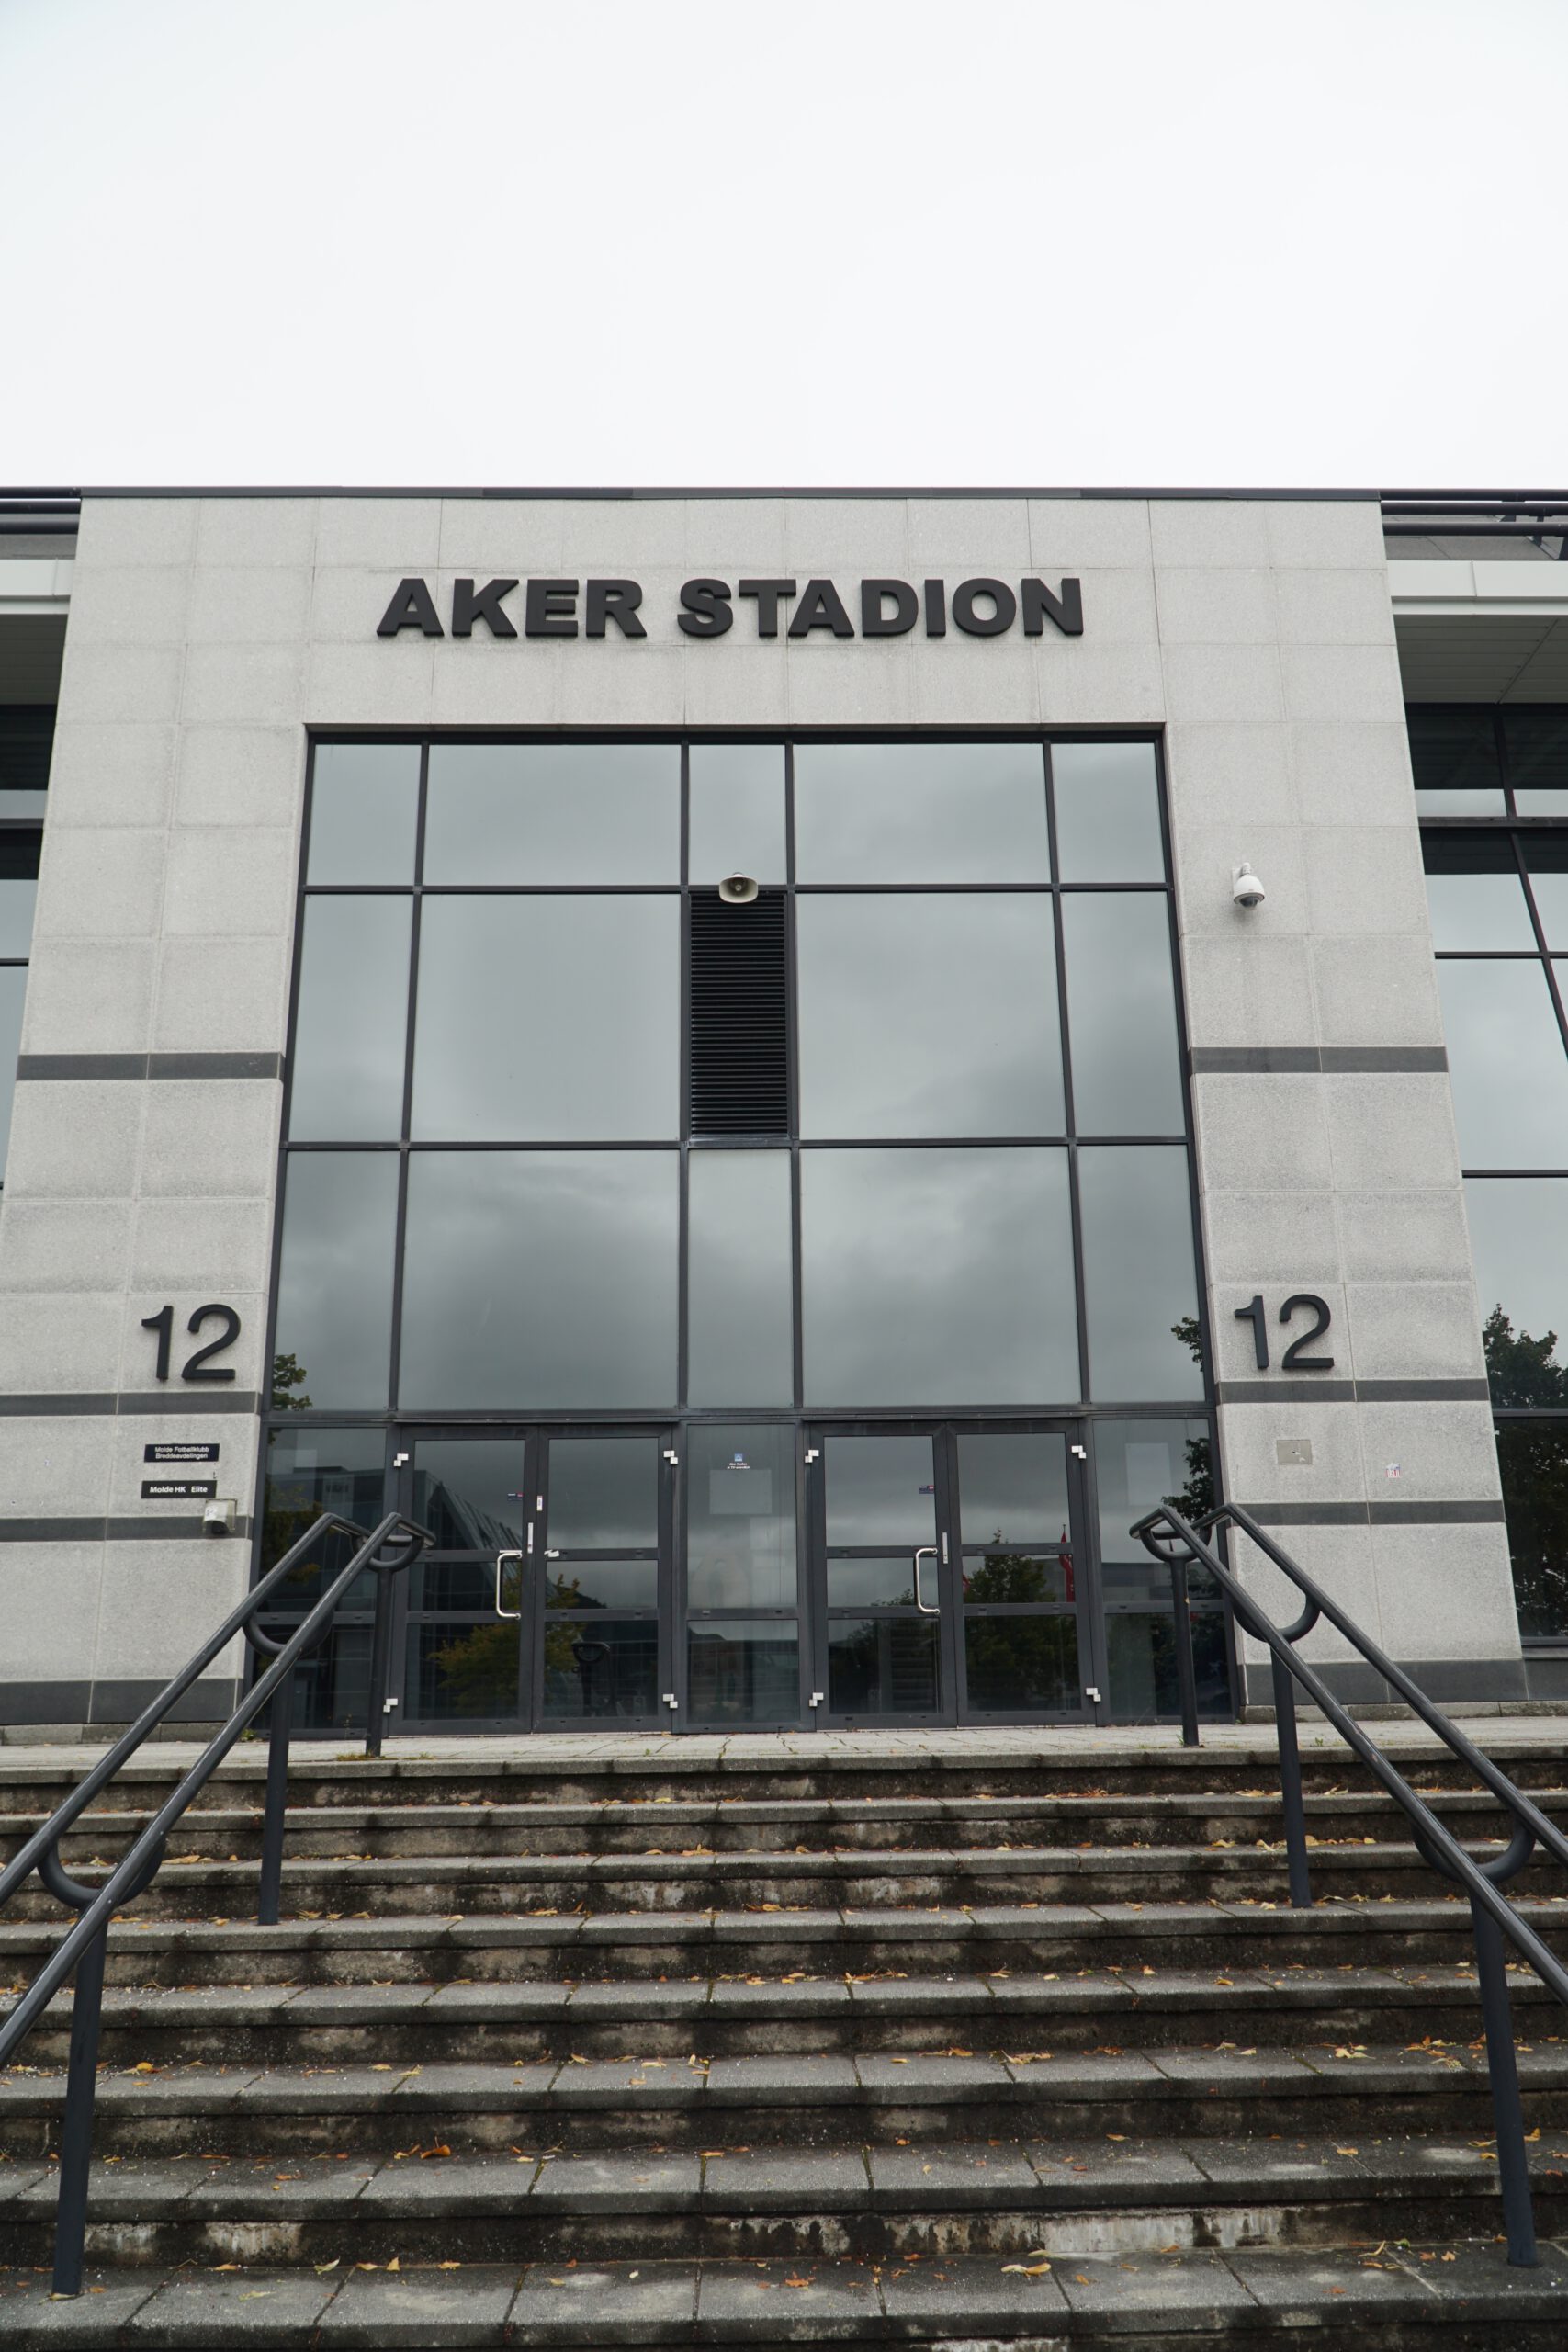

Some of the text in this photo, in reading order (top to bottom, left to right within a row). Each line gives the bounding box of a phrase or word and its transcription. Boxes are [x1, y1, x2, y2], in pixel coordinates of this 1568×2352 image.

[377, 578, 1084, 640] AKER STADION
[141, 1303, 242, 1381] 12
[1234, 1294, 1335, 1370] 12
